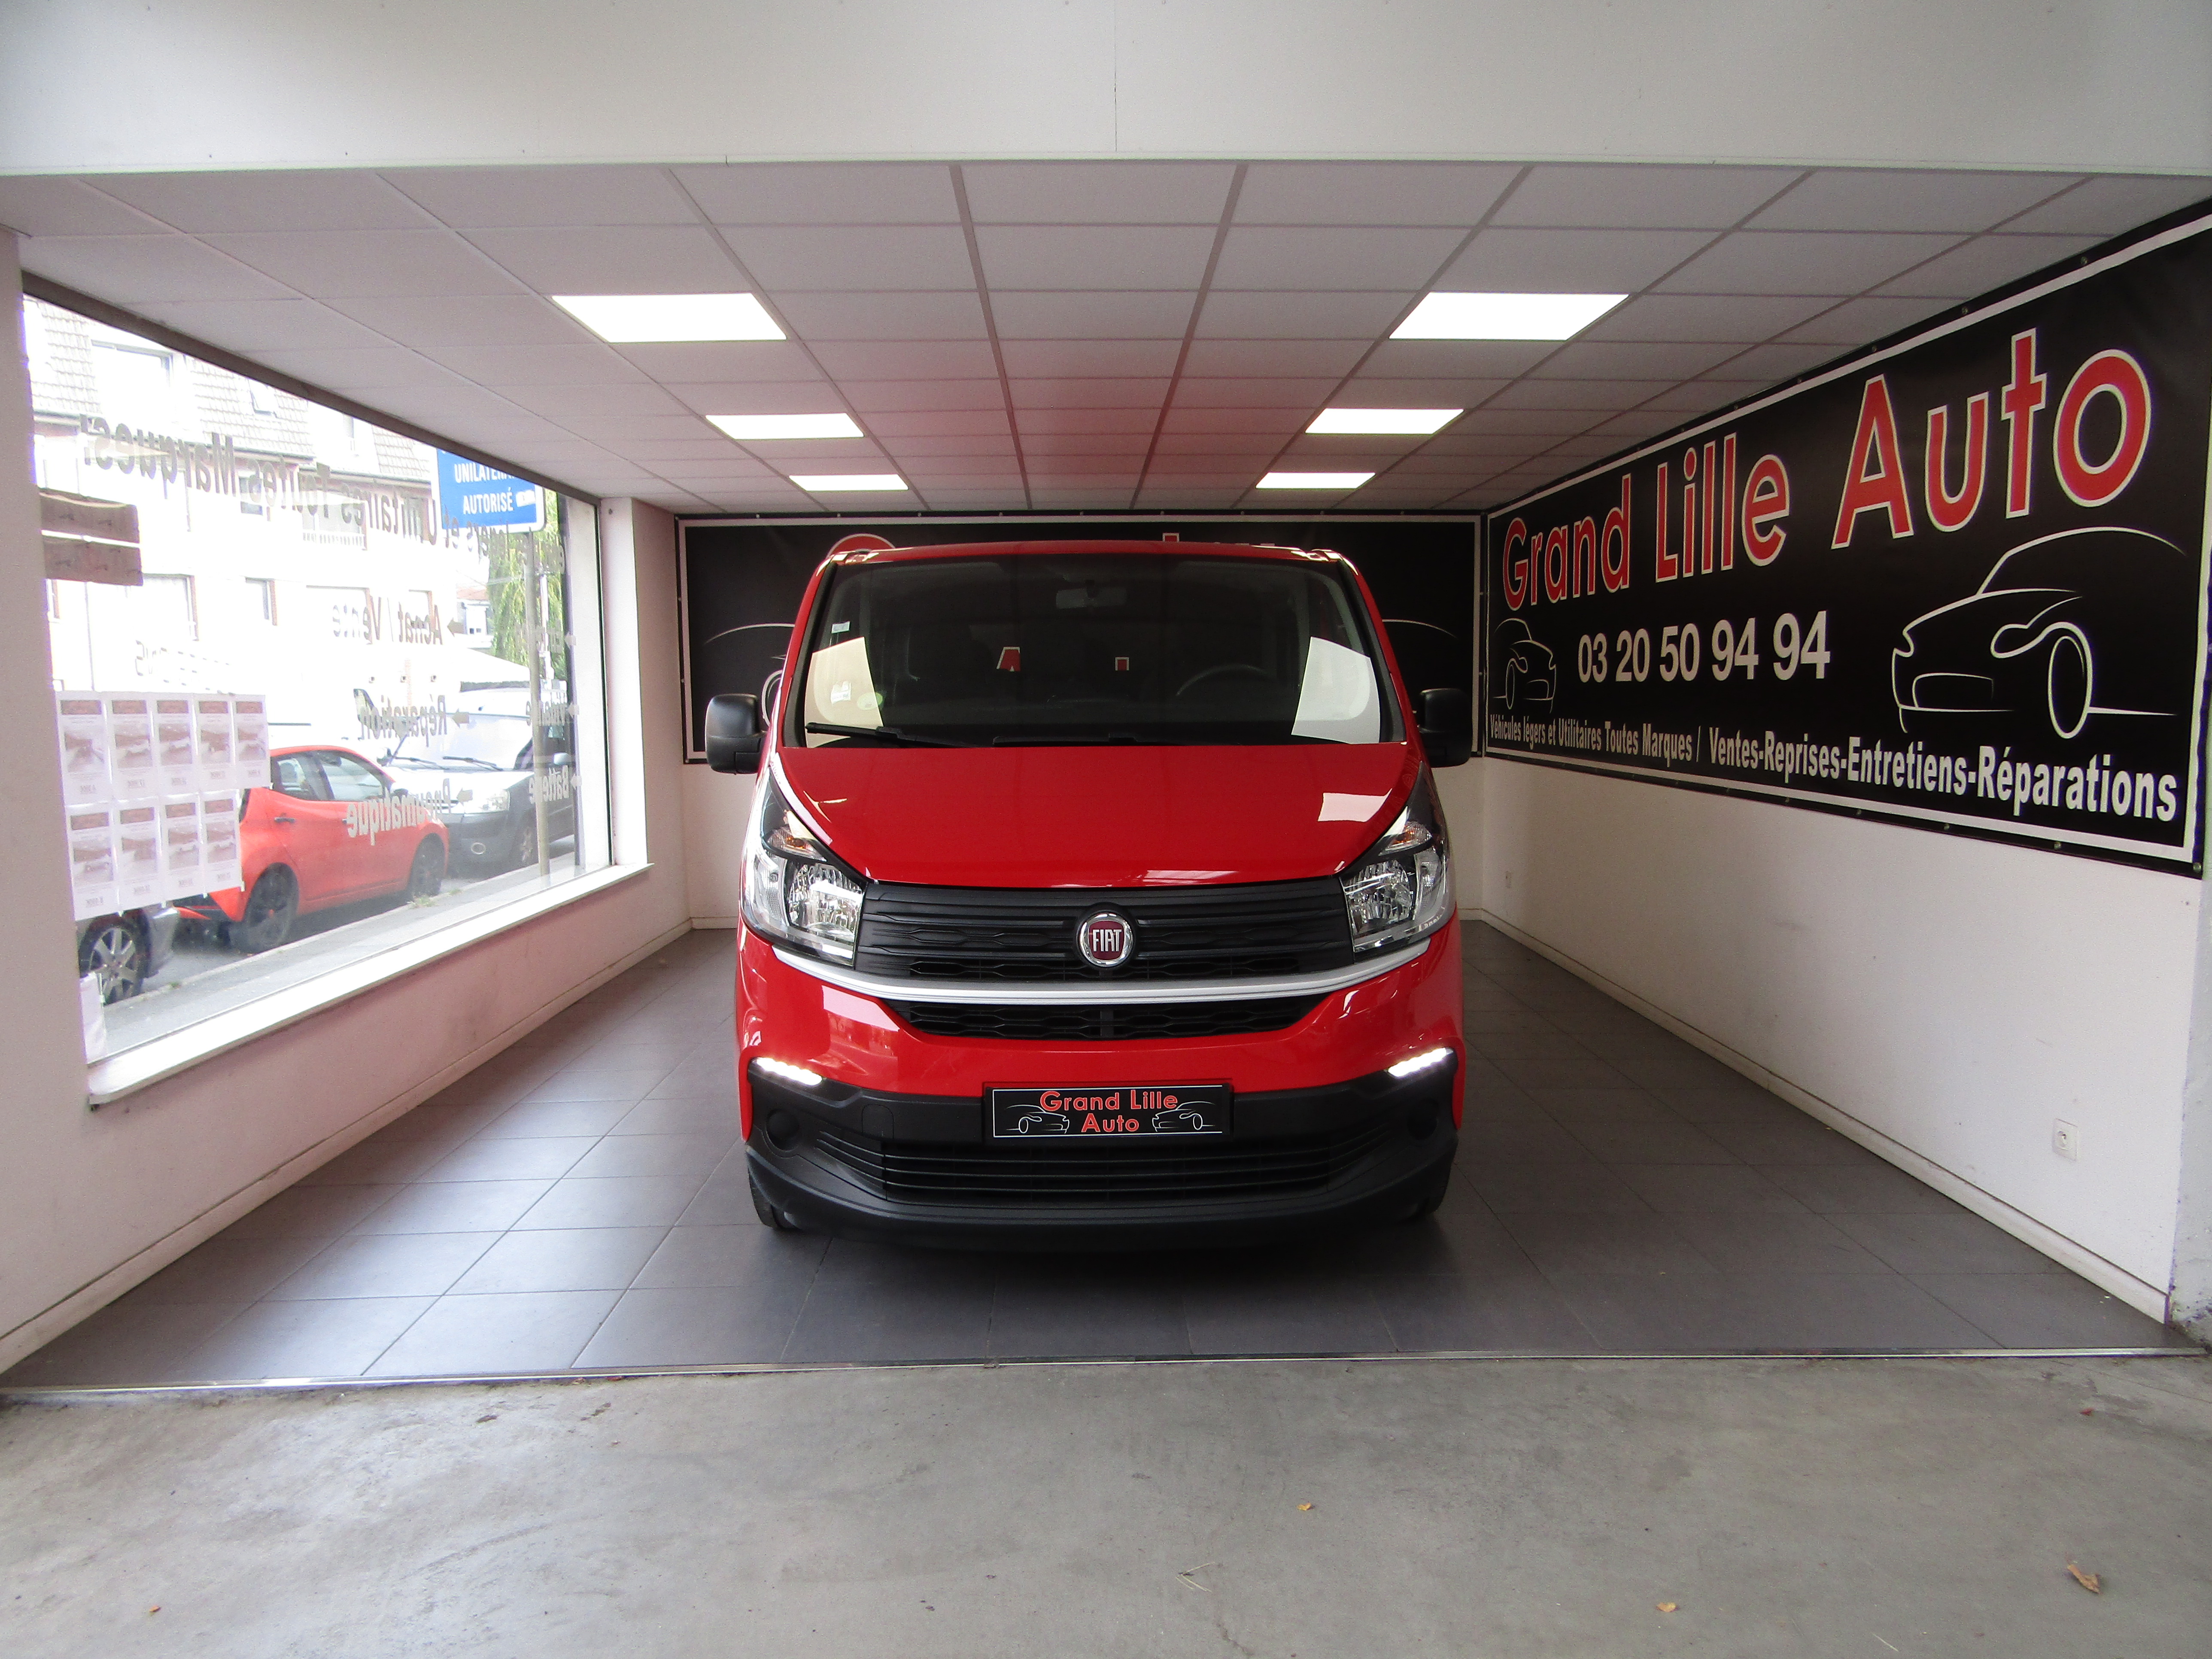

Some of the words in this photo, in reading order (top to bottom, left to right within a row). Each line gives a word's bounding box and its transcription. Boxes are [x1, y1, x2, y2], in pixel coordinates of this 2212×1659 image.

[454, 462, 516, 483] UNILAT
[1503, 473, 1632, 611] Grand
[1656, 432, 1790, 582] Lille
[1831, 327, 2151, 550] Auto
[463, 487, 514, 514] AUTORISÉ
[1578, 633, 1607, 683] 03
[1615, 629, 1650, 682] 20
[1659, 623, 1700, 681] 50
[1711, 617, 1759, 681] 94
[1773, 611, 1831, 681] 94
[1490, 714, 1522, 740] Véhicules
[1523, 716, 1547, 750] légers
[1548, 718, 1556, 745] et
[1558, 717, 1602, 750] Utilitaires
[1604, 721, 1638, 755] Toutes
[1642, 723, 1692, 768] Marques
[1696, 726, 1701, 762] /
[1093, 929, 1122, 952] FIAT
[1040, 1091, 1119, 1112] Grand
[1130, 1090, 1177, 1109] Lille
[1081, 1113, 1139, 1132] Auto
